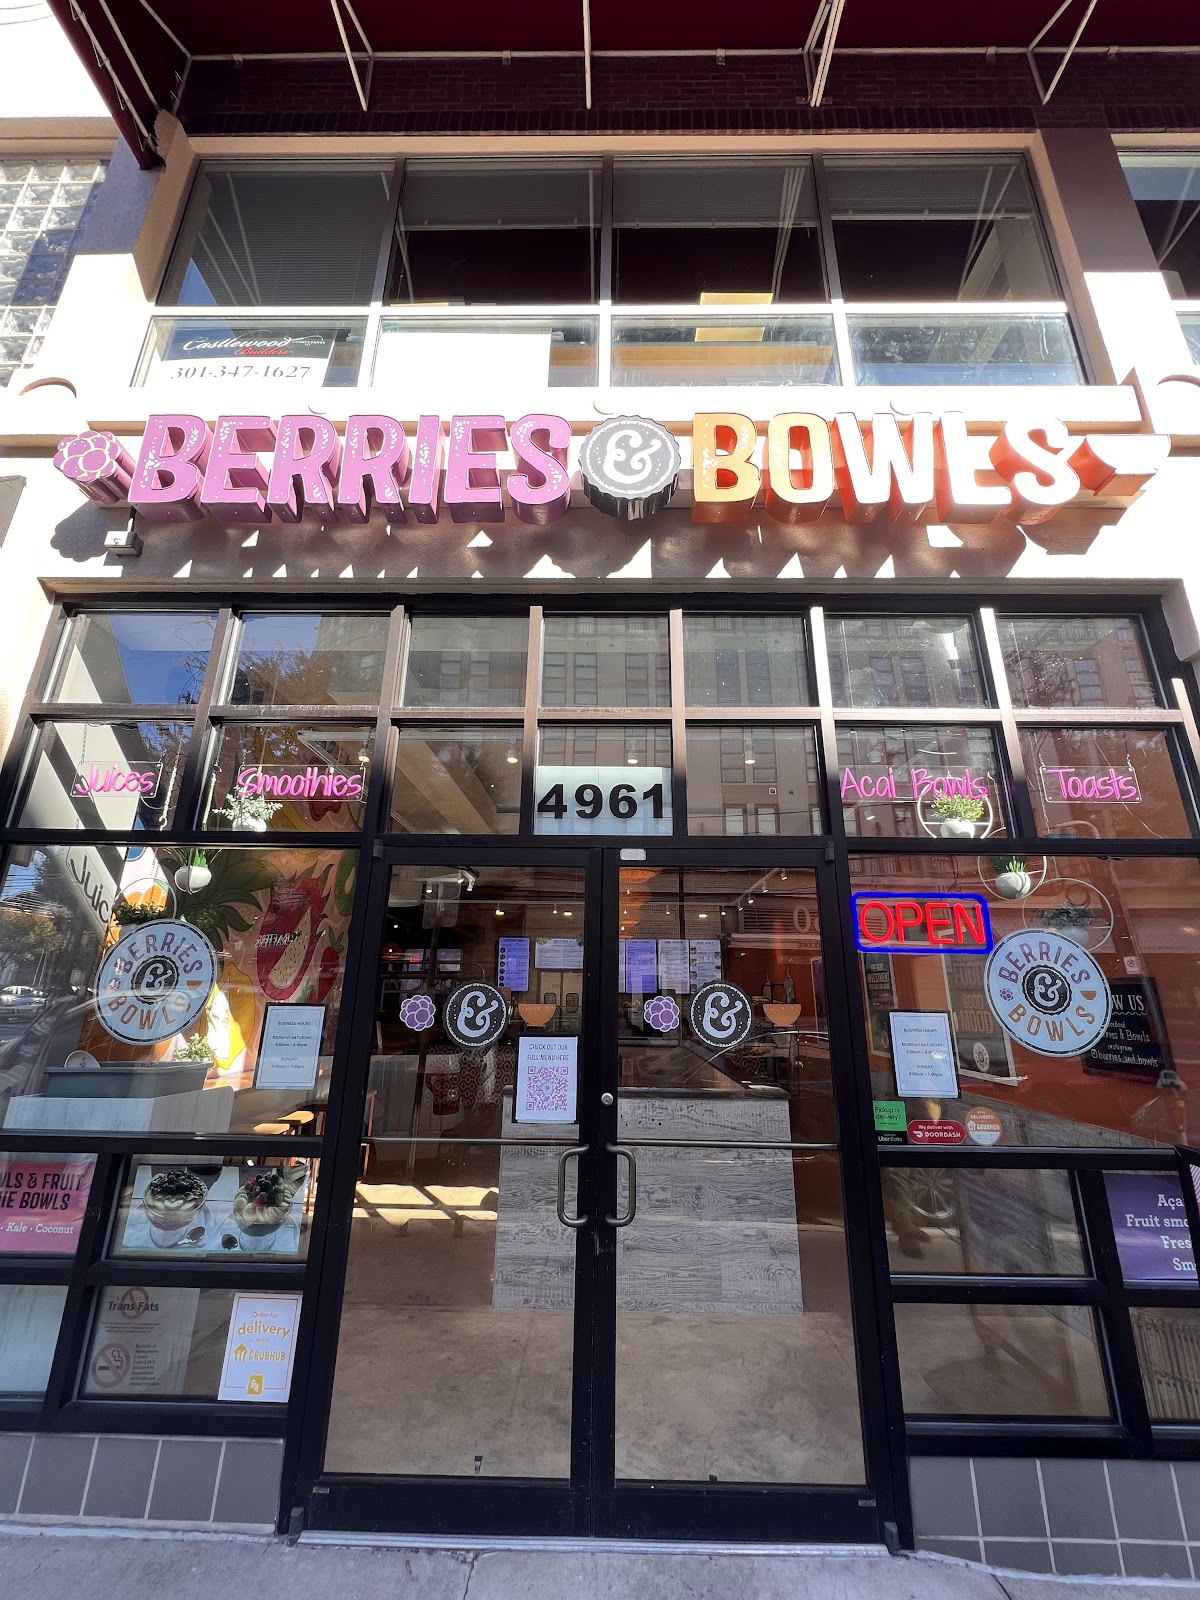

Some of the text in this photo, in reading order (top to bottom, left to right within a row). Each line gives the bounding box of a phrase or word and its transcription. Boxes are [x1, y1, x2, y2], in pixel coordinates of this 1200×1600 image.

[183, 331, 302, 351] Castlewood
[235, 346, 293, 356] Builders
[171, 365, 311, 380] 301-347-1627
[128, 411, 1082, 512] BERRIES & BOWLS
[74, 763, 155, 795] Juices
[237, 765, 362, 798] Smoothies
[841, 767, 989, 800] Acai Bowls
[1045, 768, 1138, 799] Toasts
[537, 783, 664, 819] 4961
[858, 901, 986, 946] OPEN
[114, 931, 203, 975] BERRIES
[998, 941, 1091, 985] BERRIES
[107, 992, 192, 1030] BOWLS
[1127, 994, 1145, 1011] US
[456, 990, 499, 1038] &
[702, 991, 743, 1038] &
[1007, 1003, 1096, 1042] BOWLS
[1126, 1030, 1150, 1042] Bowls
[546, 1043, 557, 1051] OUT
[558, 1043, 568, 1051] OUR
[28, 1173, 37, 1189] &
[42, 1173, 85, 1191] FRUIT
[19, 1192, 71, 1210] BOWLS
[6, 1222, 75, 1234] Kale Coconut
[1125, 1214, 1161, 1227] Fruit
[1160, 1234, 1193, 1249] Fres
[1173, 1258, 1197, 1271] Sm
[108, 1301, 159, 1311] Trans Fats
[252, 1311, 278, 1319] Order for
[237, 1320, 291, 1340] delivery
[248, 1350, 286, 1361] GRUBHUB
